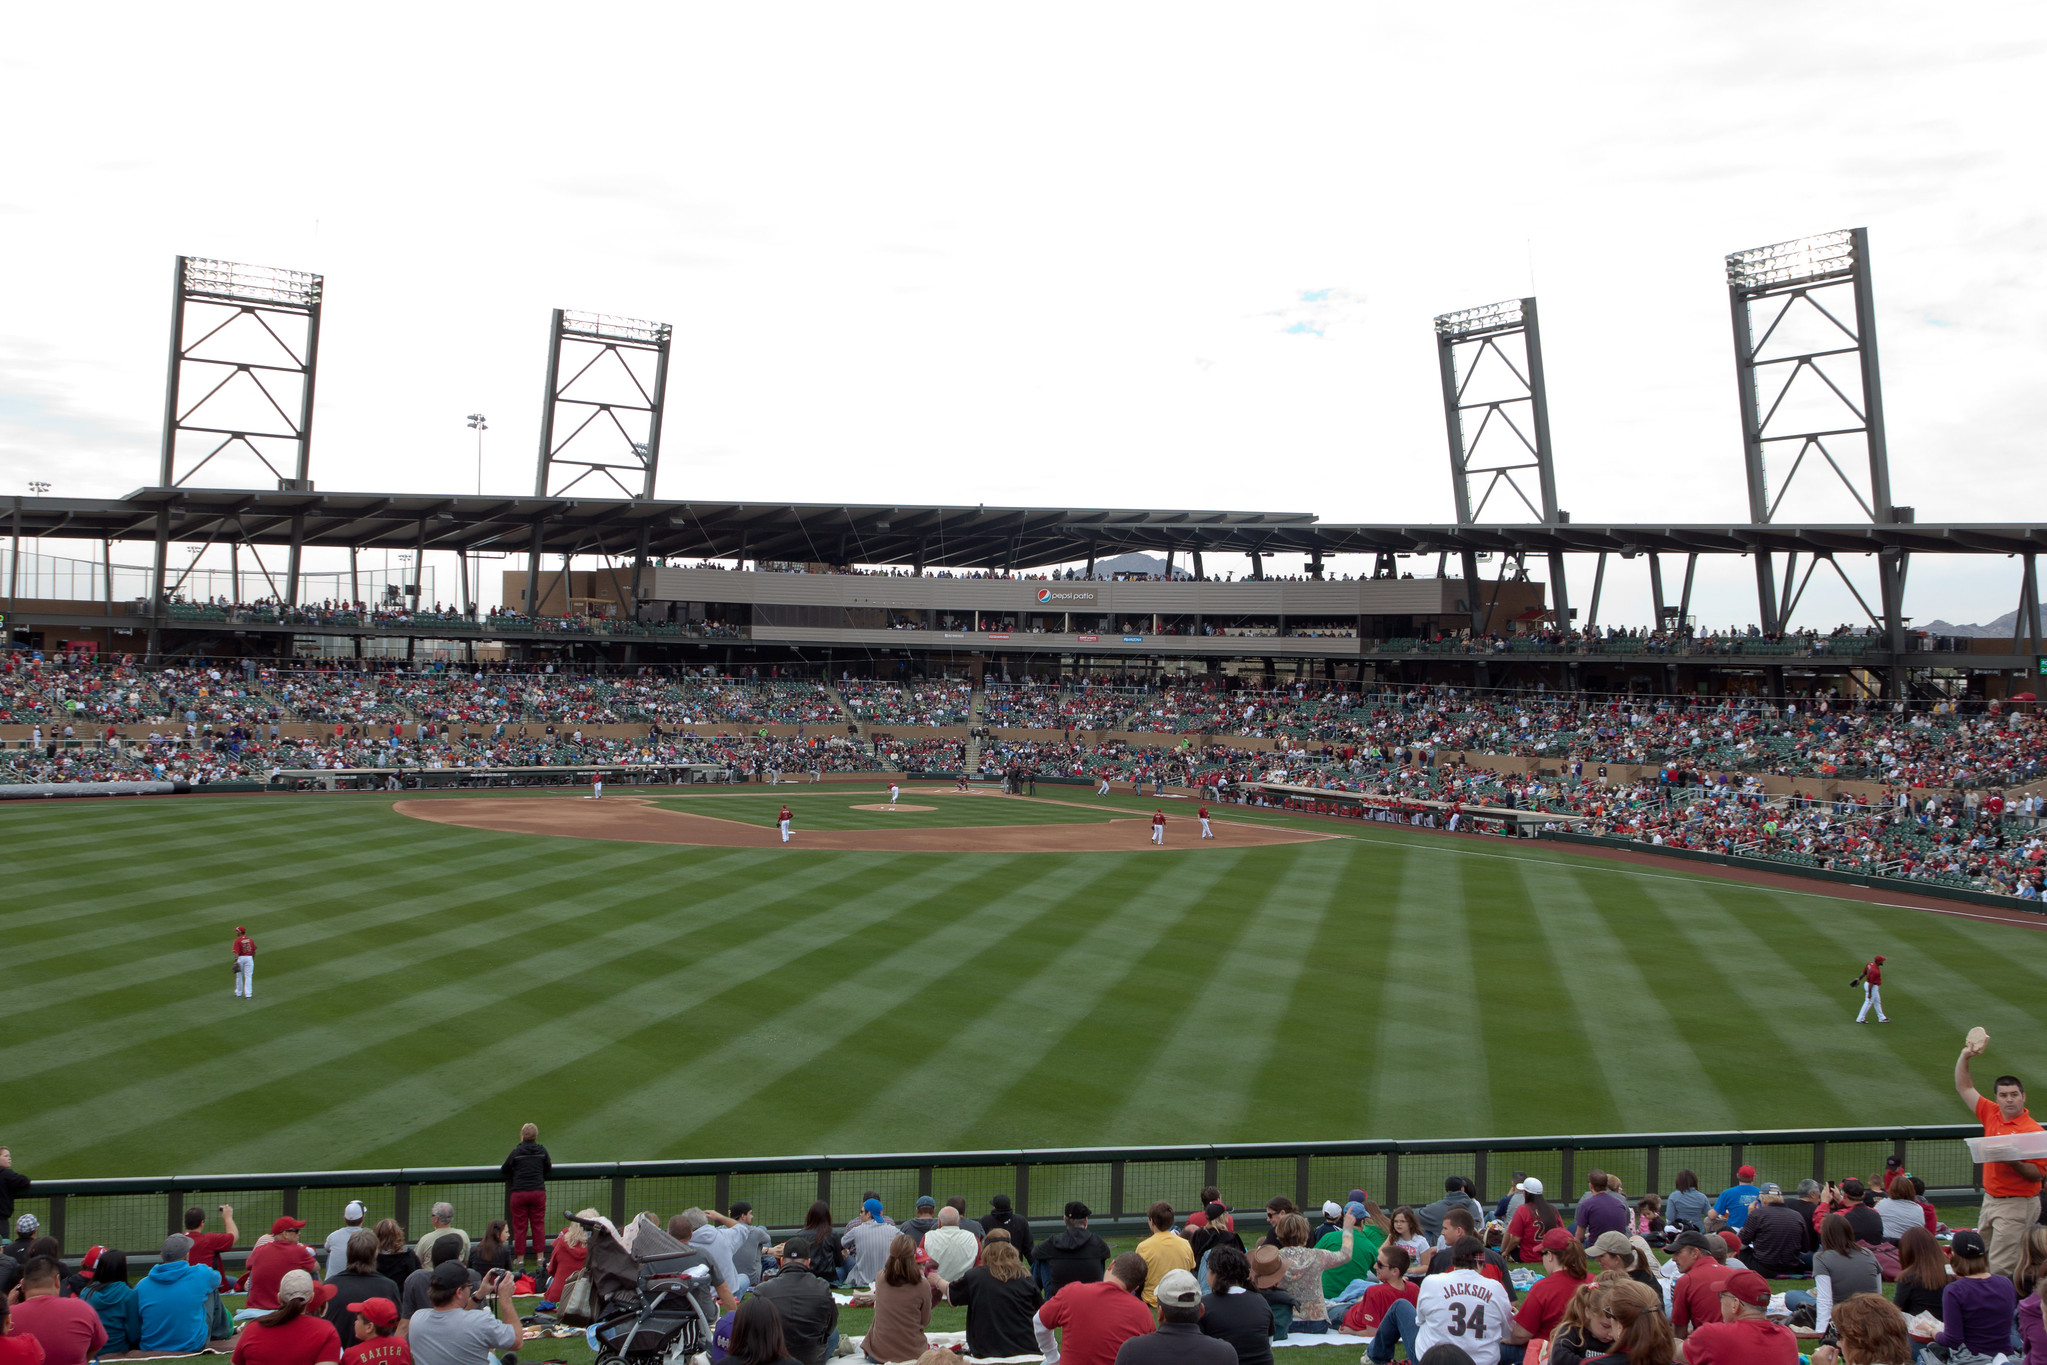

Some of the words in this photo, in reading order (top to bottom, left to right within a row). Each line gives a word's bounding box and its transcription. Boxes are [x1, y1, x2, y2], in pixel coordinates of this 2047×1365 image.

[1052, 592, 1072, 600] pepsi
[1073, 592, 1094, 600] patio
[1443, 1282, 1493, 1303] JACKSON
[1447, 1301, 1487, 1339] 34
[360, 1345, 402, 1363] BAXTER
